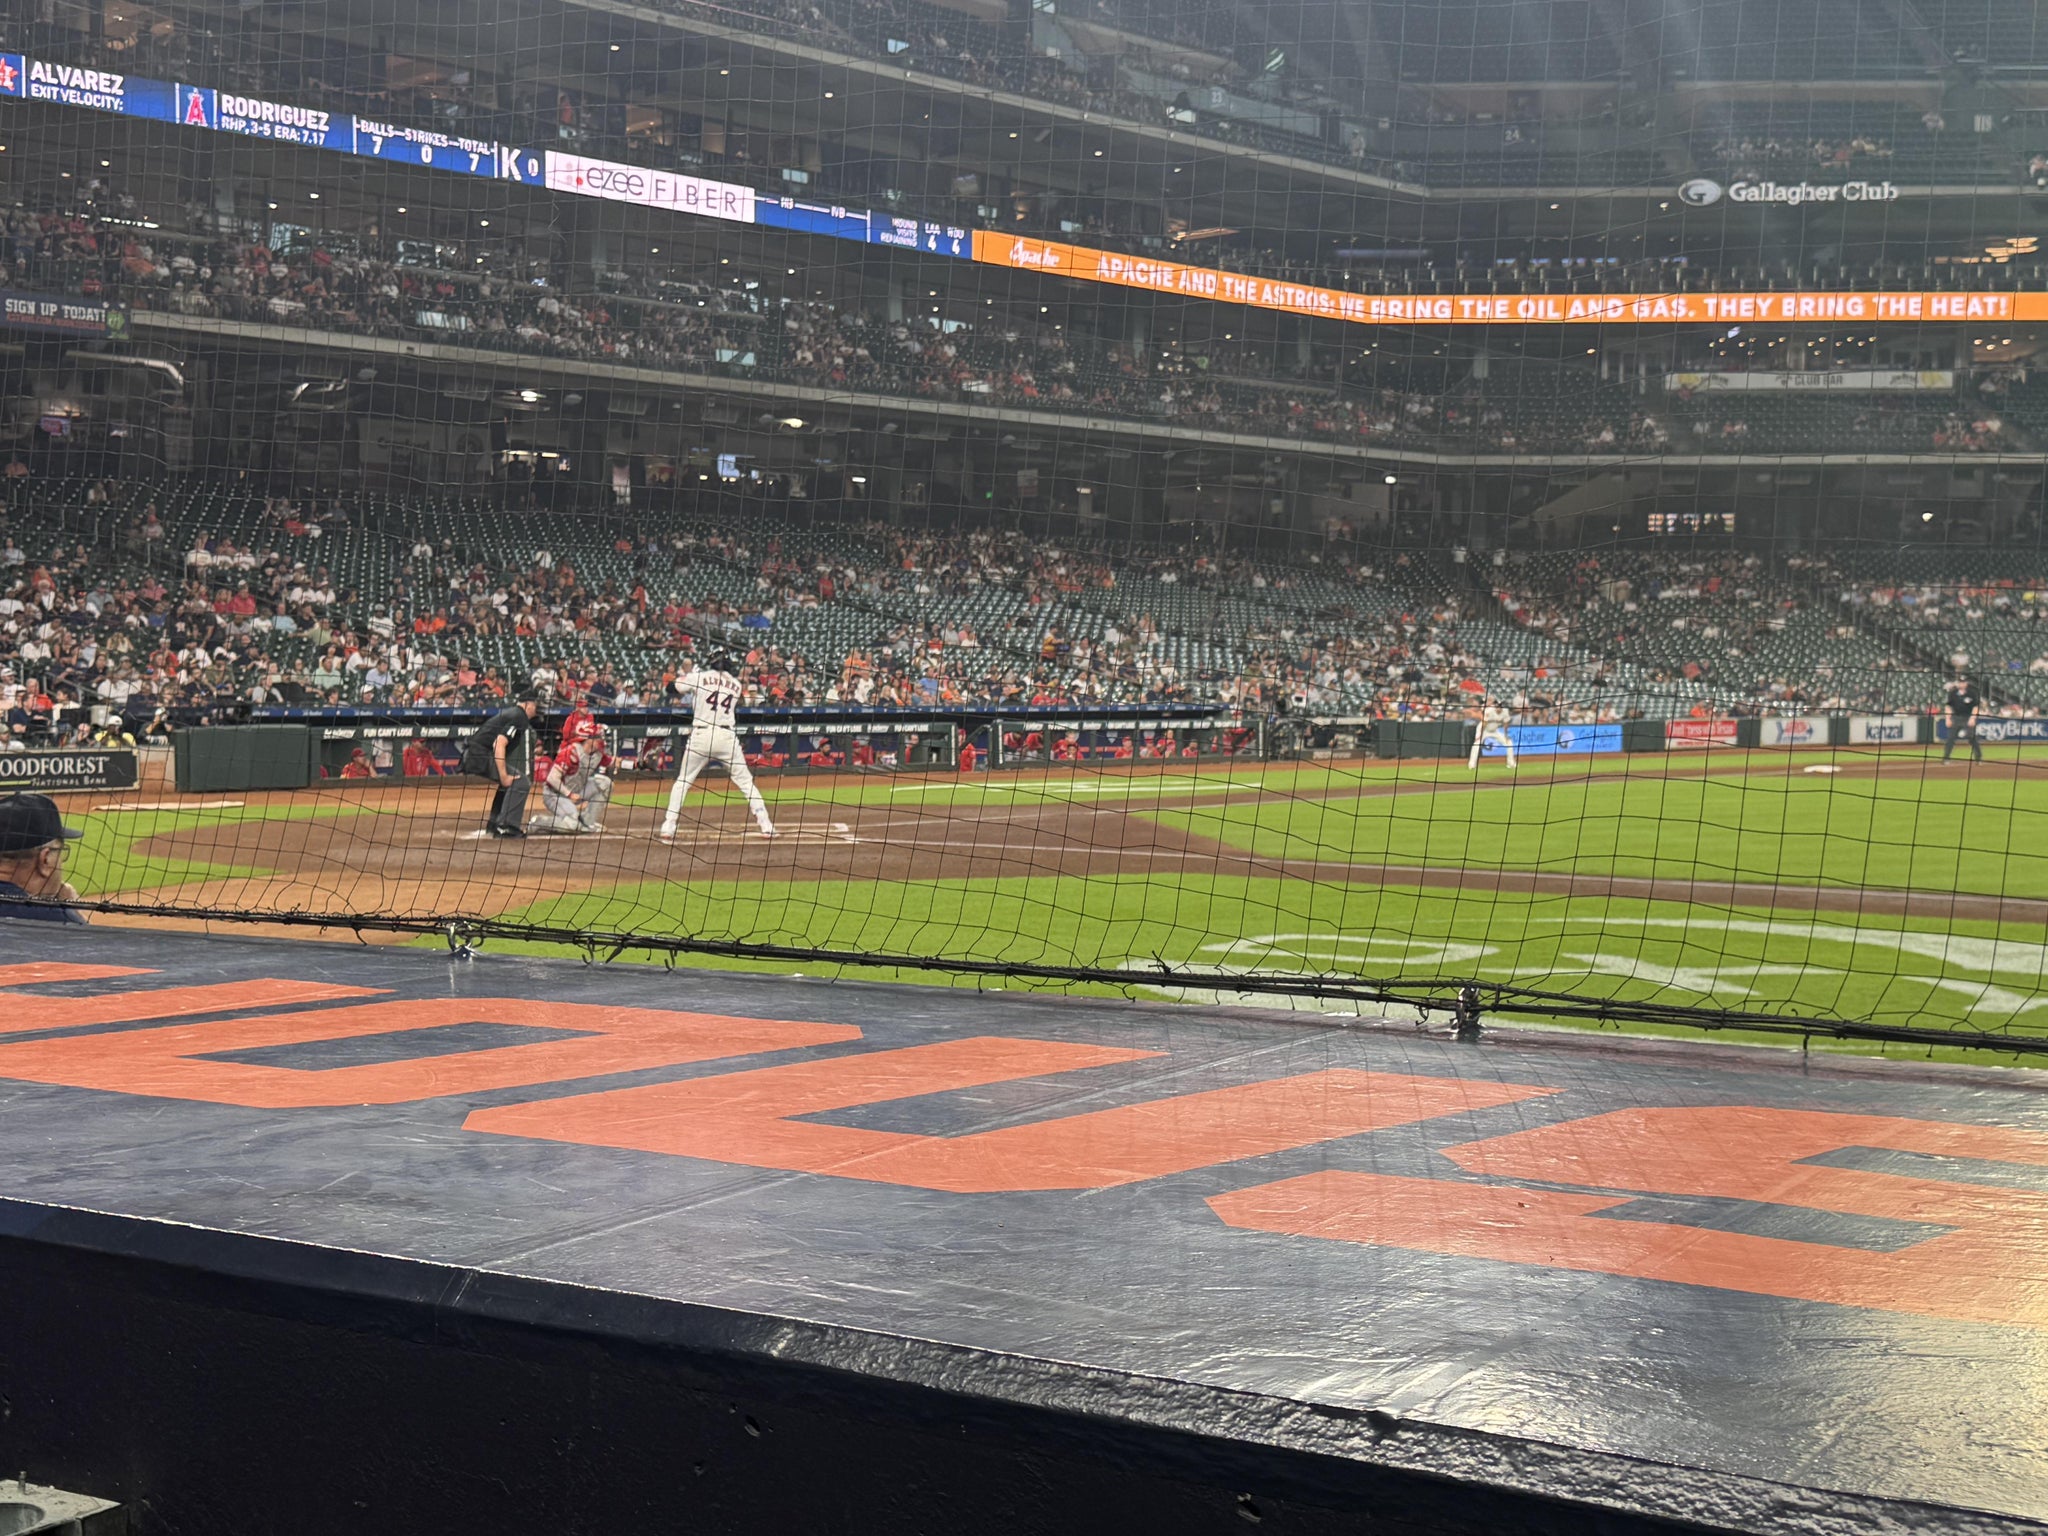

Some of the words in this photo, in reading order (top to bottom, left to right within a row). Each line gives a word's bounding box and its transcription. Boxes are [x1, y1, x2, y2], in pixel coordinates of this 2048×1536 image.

[30, 61, 124, 95] ALVAREZ
[31, 83, 60, 101] EXIT
[60, 88, 124, 111] VELOCITY:
[221, 94, 329, 131] RODRIGUEZ
[251, 122, 271, 136] 3-5
[274, 125, 300, 142] ERA:
[303, 130, 325, 145] 7.17
[372, 136, 382, 154] 7
[421, 145, 432, 163] 0
[469, 153, 479, 172] 7
[502, 147, 521, 181] K
[586, 167, 643, 196] ezee
[655, 179, 737, 213] FIBER
[1728, 181, 1839, 205] Gallagher
[1842, 181, 1898, 202] Club
[928, 235, 937, 250] 4
[952, 239, 960, 255] 4
[1009, 240, 1060, 267] Apache
[1096, 255, 1173, 288] APACHE
[1179, 270, 1217, 295] AND
[1223, 276, 1257, 301] THE
[1340, 296, 1365, 319] WE
[1371, 299, 1450, 319] BRING
[1460, 299, 1509, 318] THE
[1517, 299, 1560, 318] OIL
[1568, 299, 1626, 318] AND
[1632, 299, 1695, 318] GAS.
[1704, 297, 1774, 318] THEY
[1782, 297, 1864, 317] BRING
[1872, 297, 1921, 317] THE
[1931, 296, 2007, 317] HEAT!
[5, 299, 36, 315] SIGN
[40, 302, 58, 316] UP
[62, 305, 105, 323] TODAY!
[706, 690, 734, 714] 44
